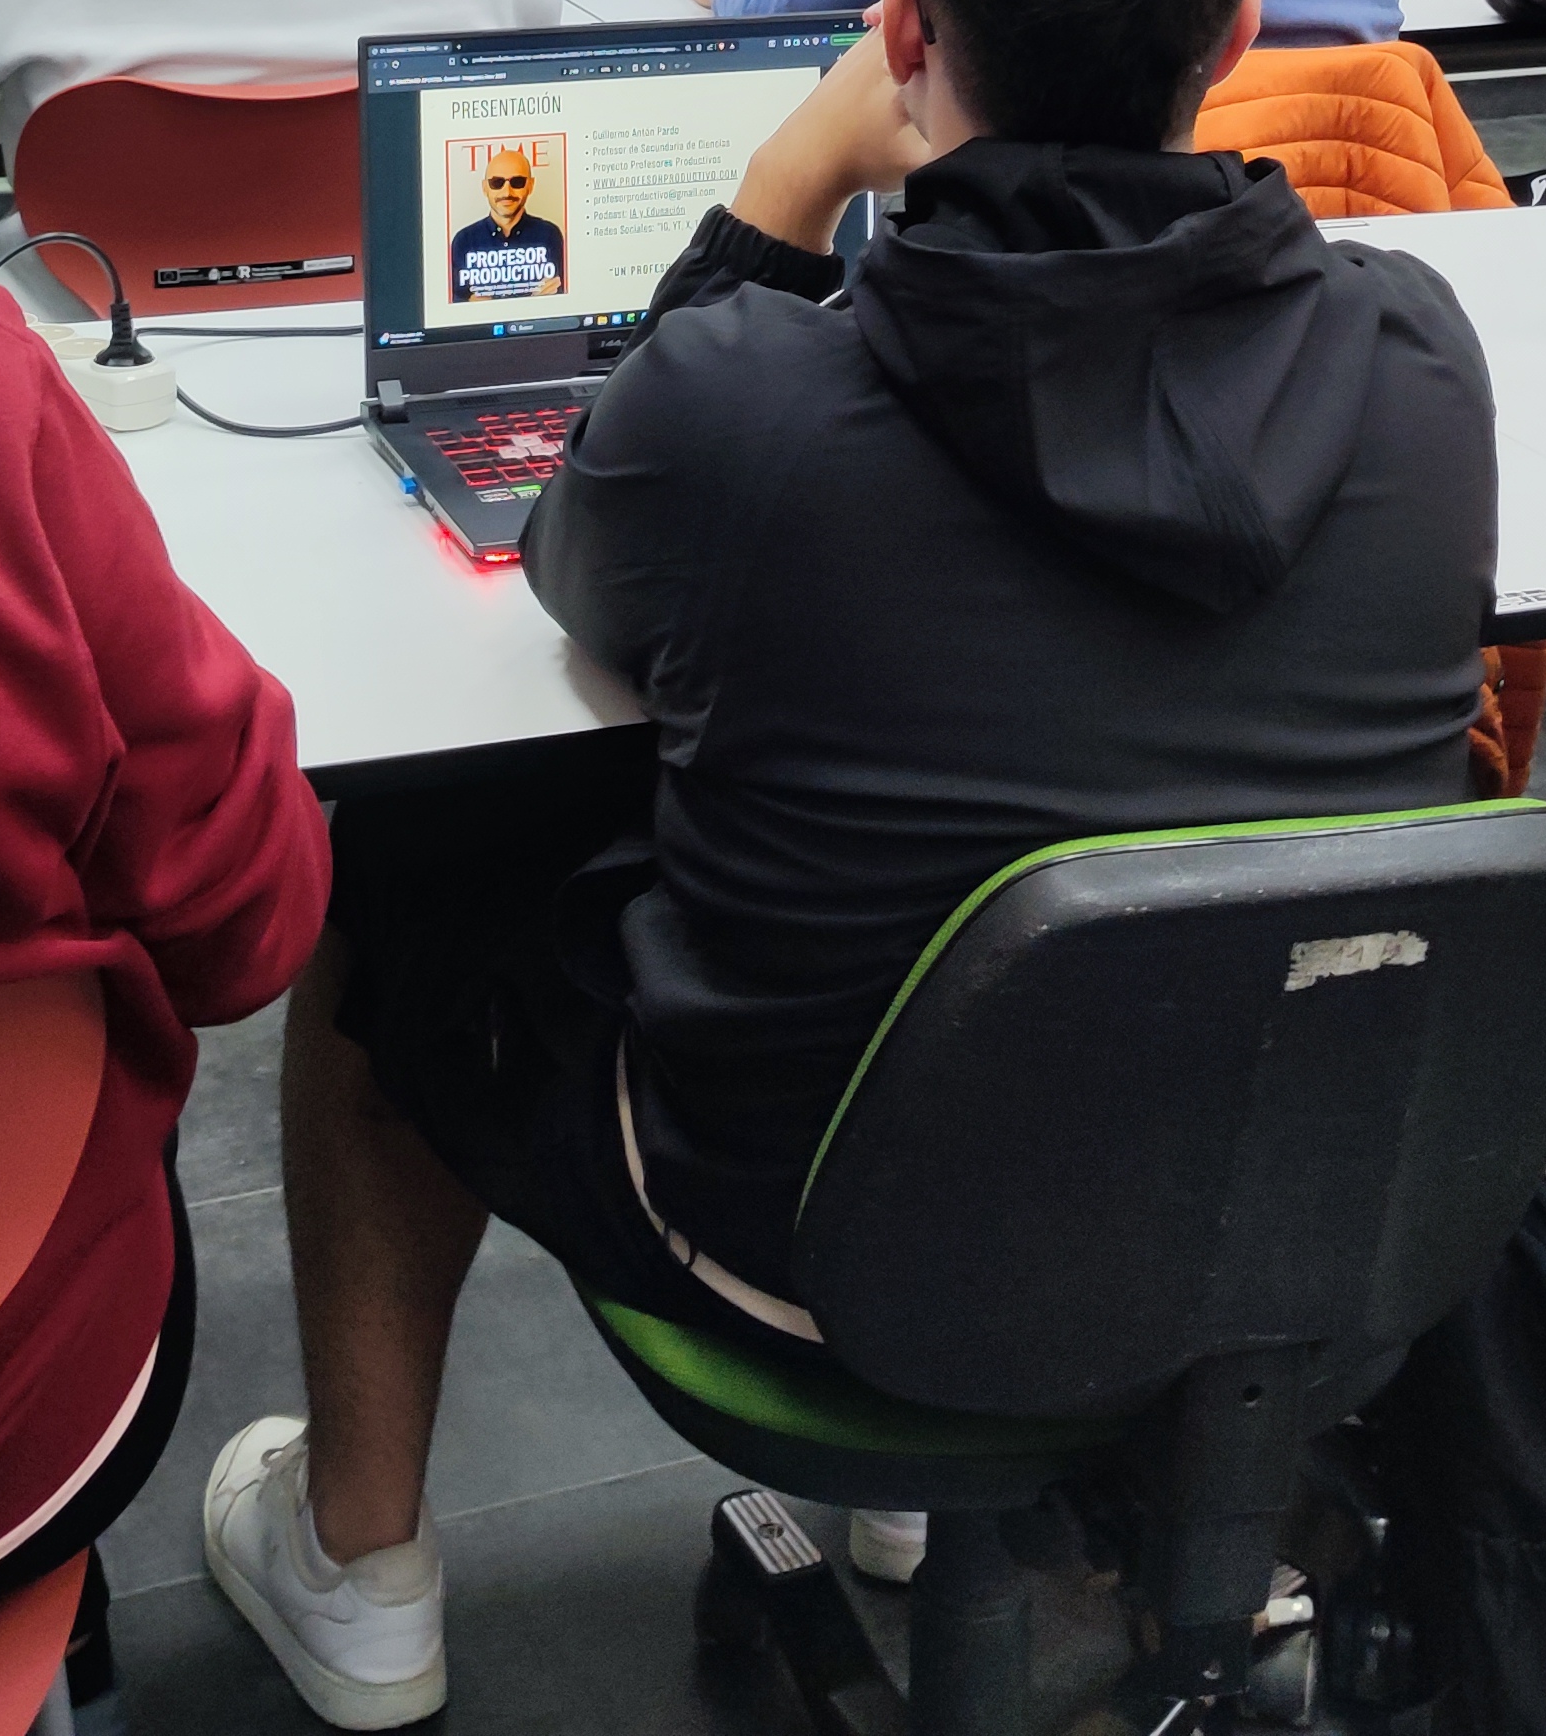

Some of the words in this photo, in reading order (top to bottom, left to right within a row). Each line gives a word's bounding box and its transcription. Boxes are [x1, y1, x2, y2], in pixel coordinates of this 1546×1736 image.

[452, 92, 561, 119] PRESENTACIÓN
[592, 129, 630, 141] Guillermo
[657, 125, 679, 136] Pardo
[461, 141, 550, 171] TIE
[592, 146, 626, 157] Profesor
[593, 161, 628, 174] Proyecto
[631, 159, 673, 170] Profesores
[675, 155, 721, 167] Productivos
[593, 226, 618, 237] Redes
[466, 246, 548, 269] PROFESOR
[459, 262, 556, 287] PRODUCTIVO
